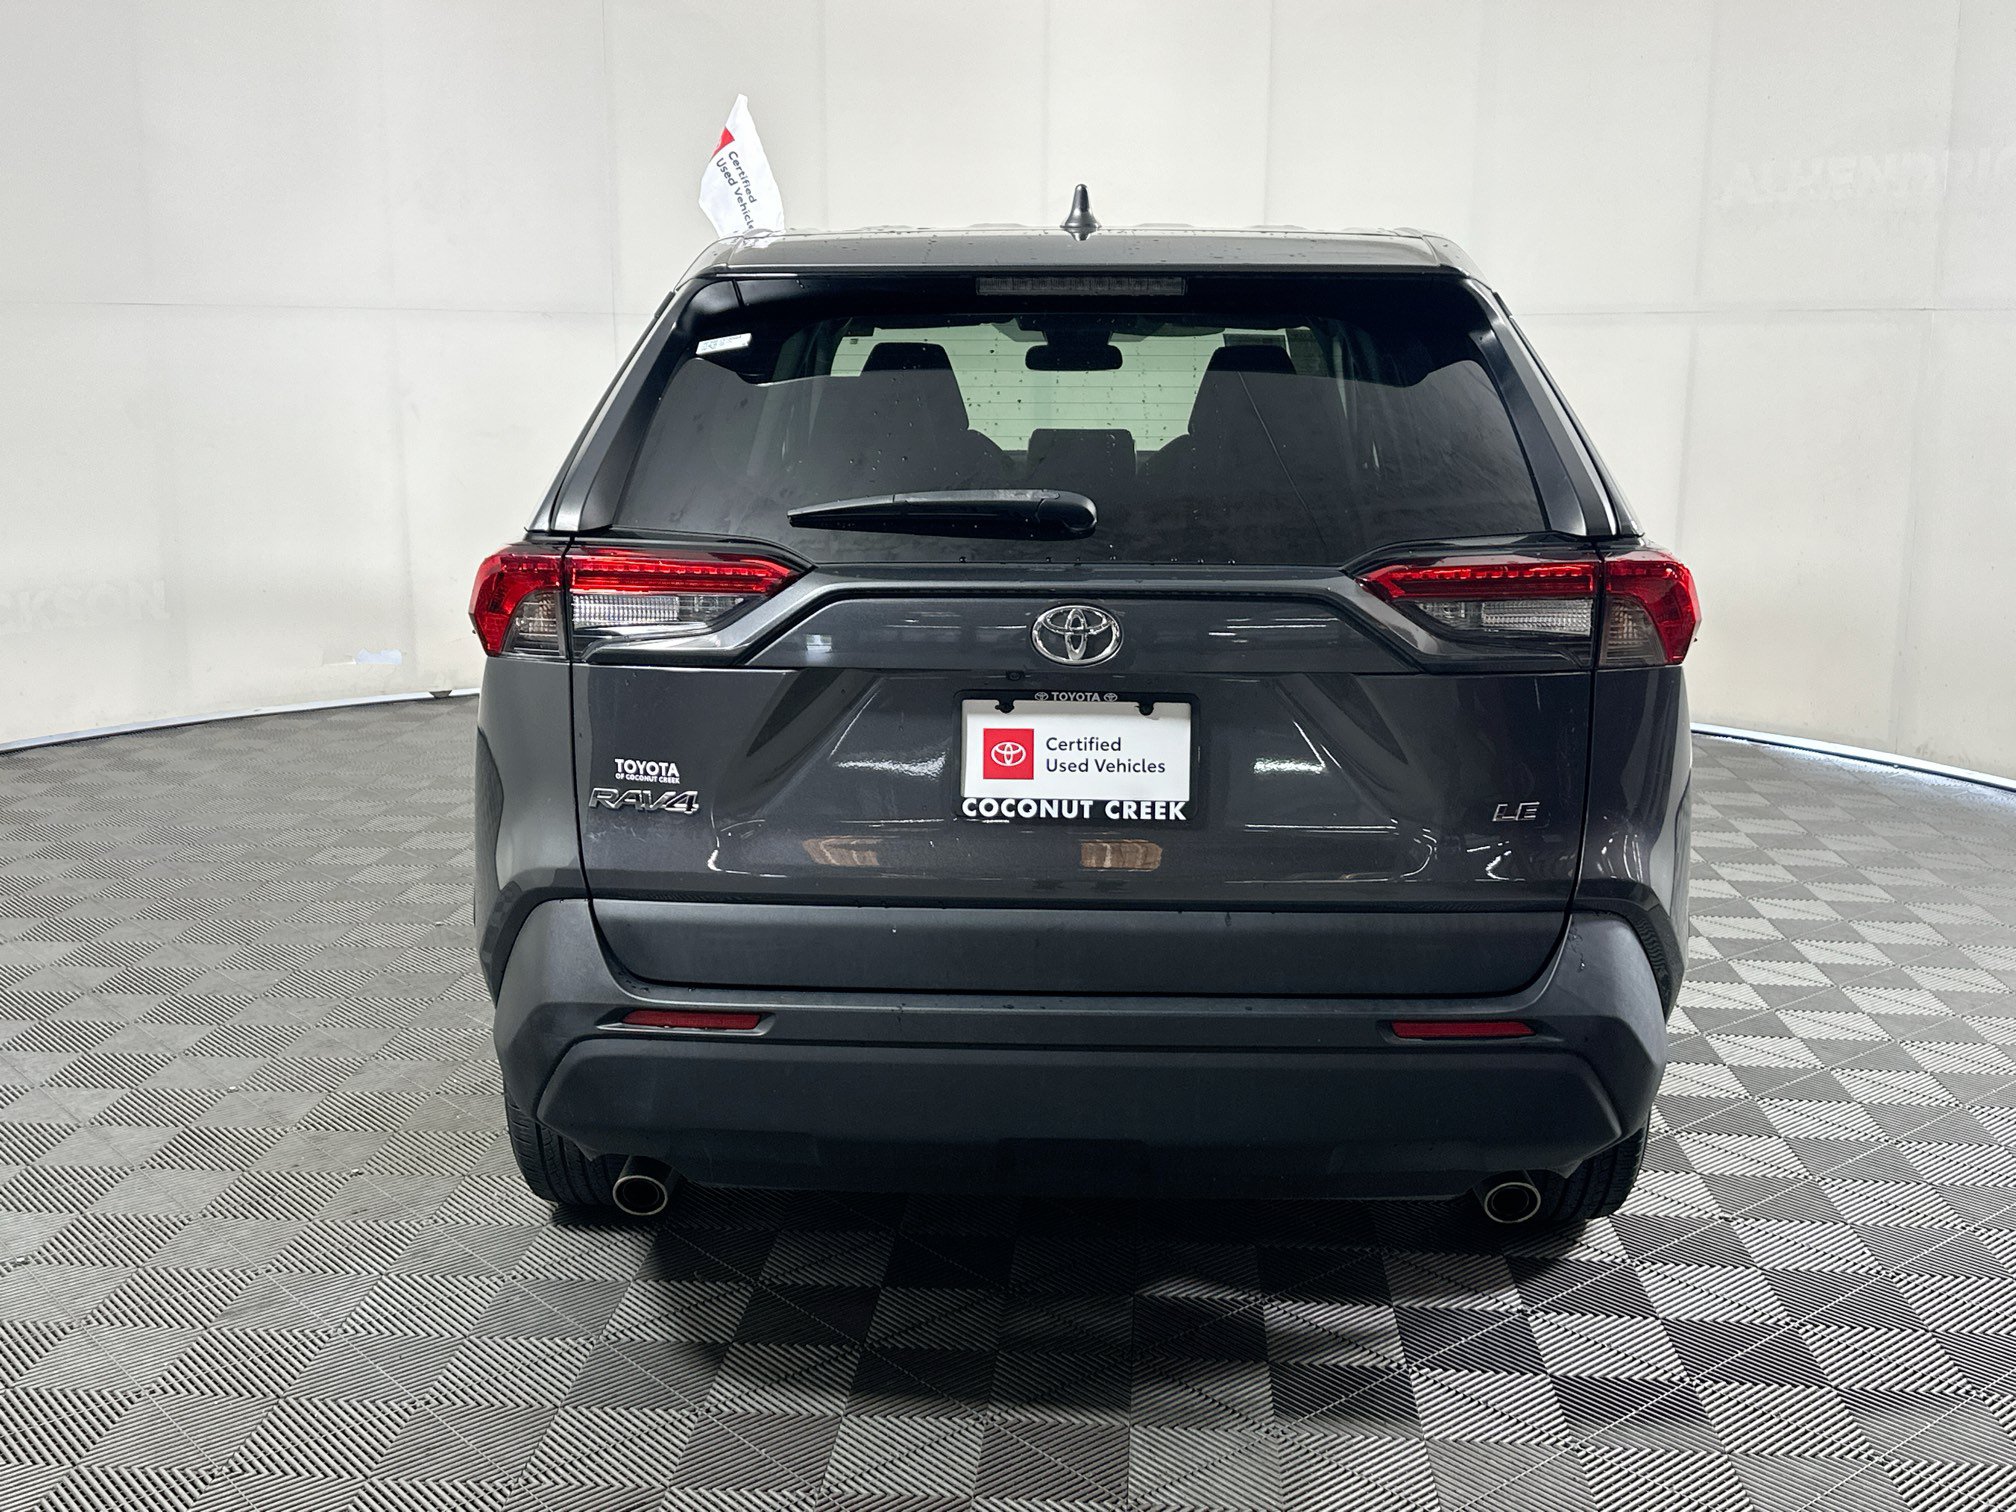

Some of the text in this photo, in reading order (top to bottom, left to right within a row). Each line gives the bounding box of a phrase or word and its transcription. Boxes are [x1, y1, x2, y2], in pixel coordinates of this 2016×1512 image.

[716, 158, 738, 186] Used
[728, 150, 757, 203] Certified
[1051, 692, 1100, 702] TOYOTA
[1046, 737, 1122, 752] Certified
[615, 758, 680, 777] TOYOTA
[1046, 758, 1166, 773] Used Vehicles
[615, 772, 680, 784] OF COCONUT CREEK
[588, 787, 700, 814] RAV4
[962, 798, 1187, 821] COCONUT CREEK
[1492, 801, 1540, 821] LE
